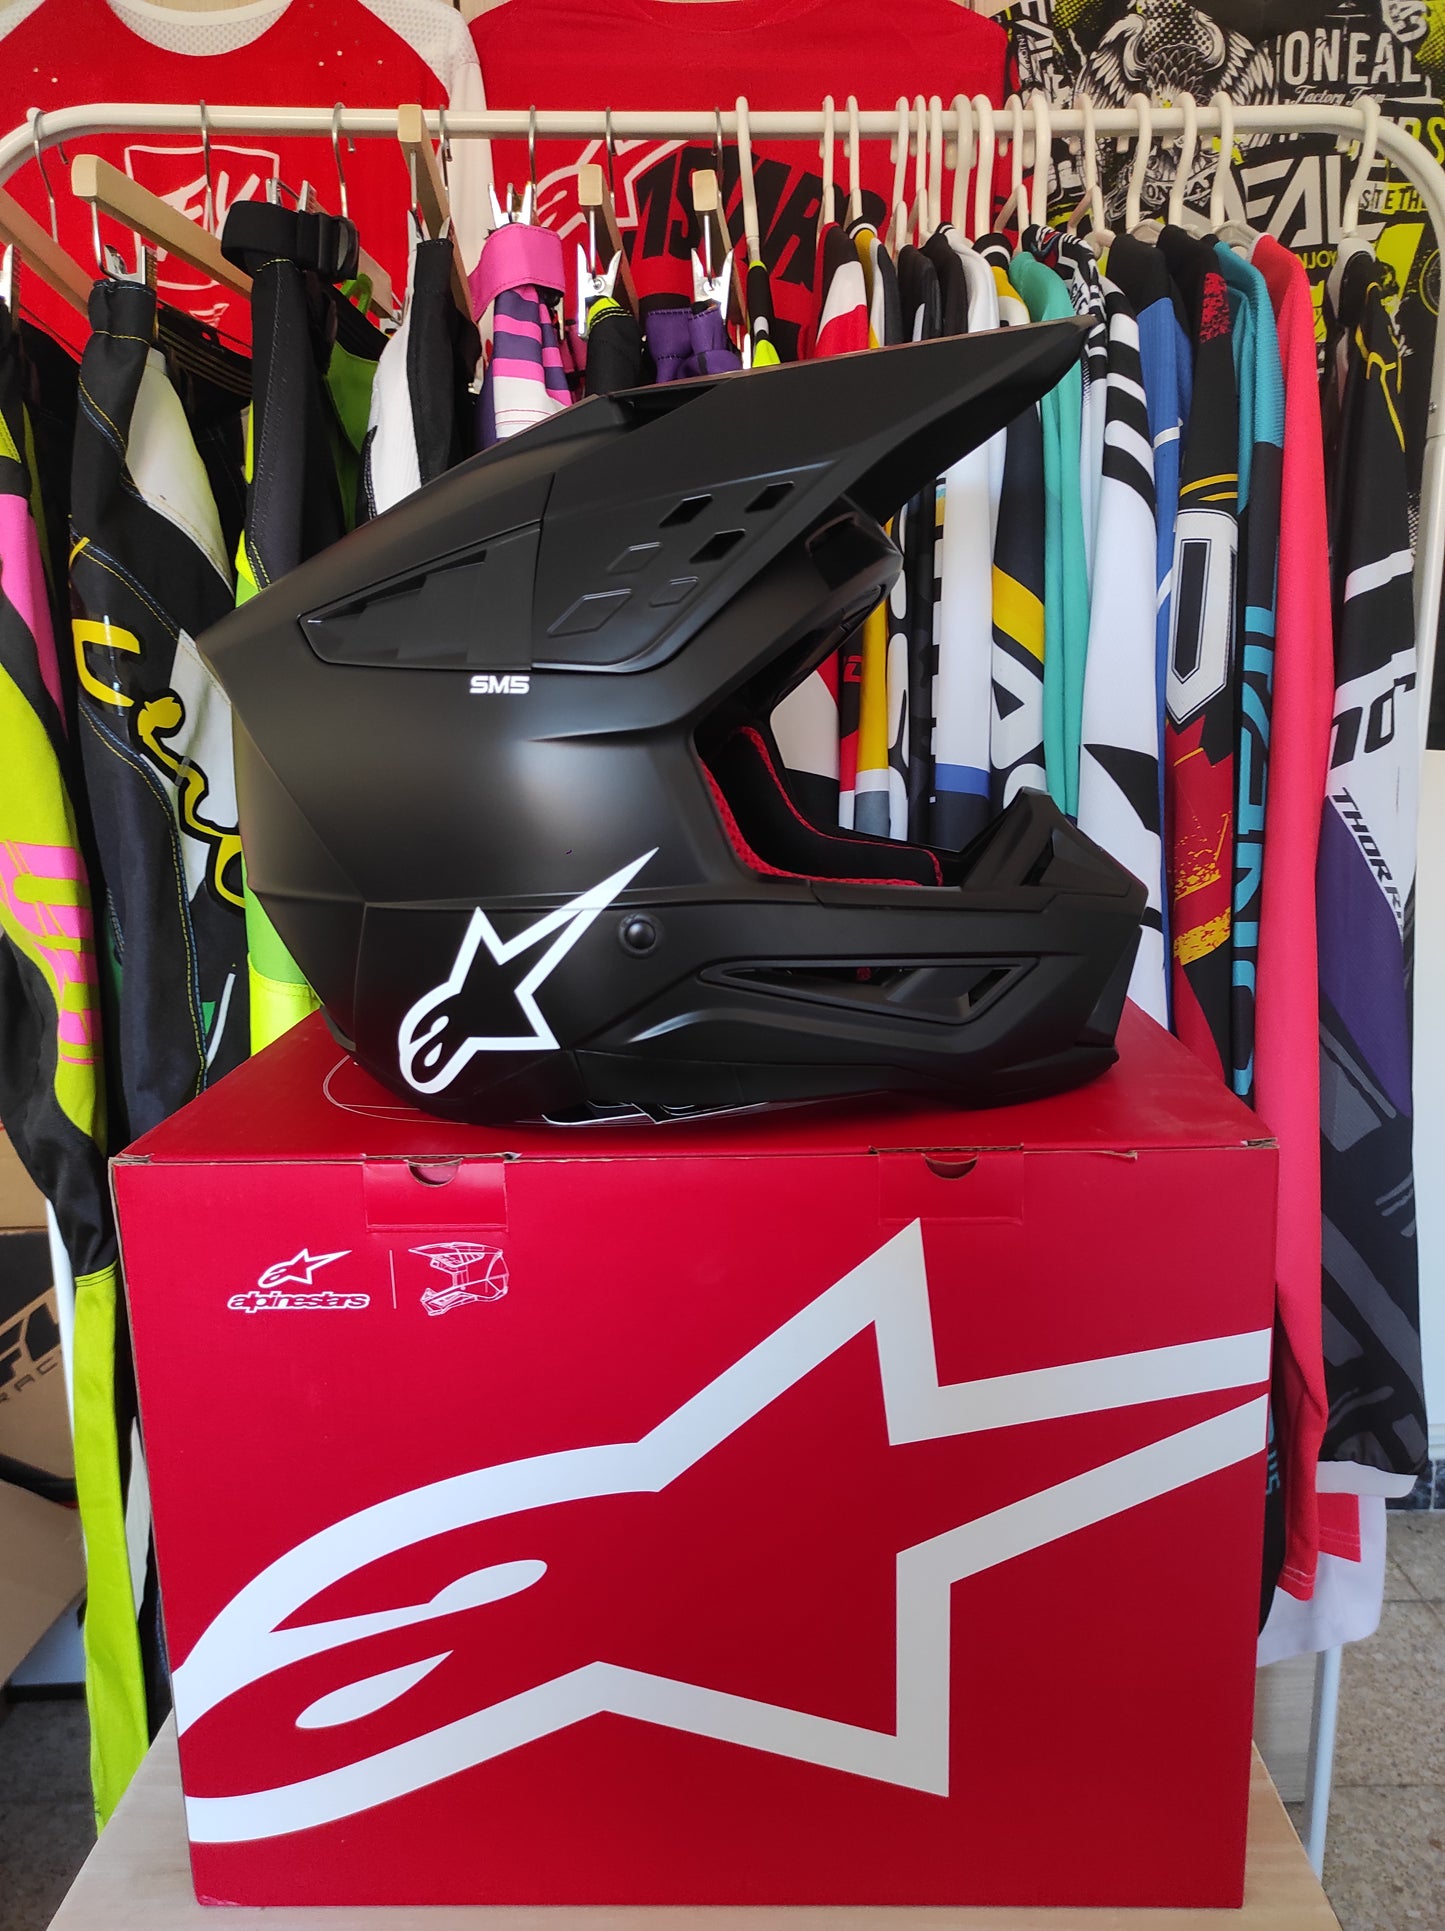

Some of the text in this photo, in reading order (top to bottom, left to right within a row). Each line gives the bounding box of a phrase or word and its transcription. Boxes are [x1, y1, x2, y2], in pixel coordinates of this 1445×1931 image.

[1284, 28, 1421, 85] ONEAL
[1291, 85, 1346, 106] Factory
[1332, 787, 1393, 883] THOR
[227, 1291, 370, 1314] alpinestars
